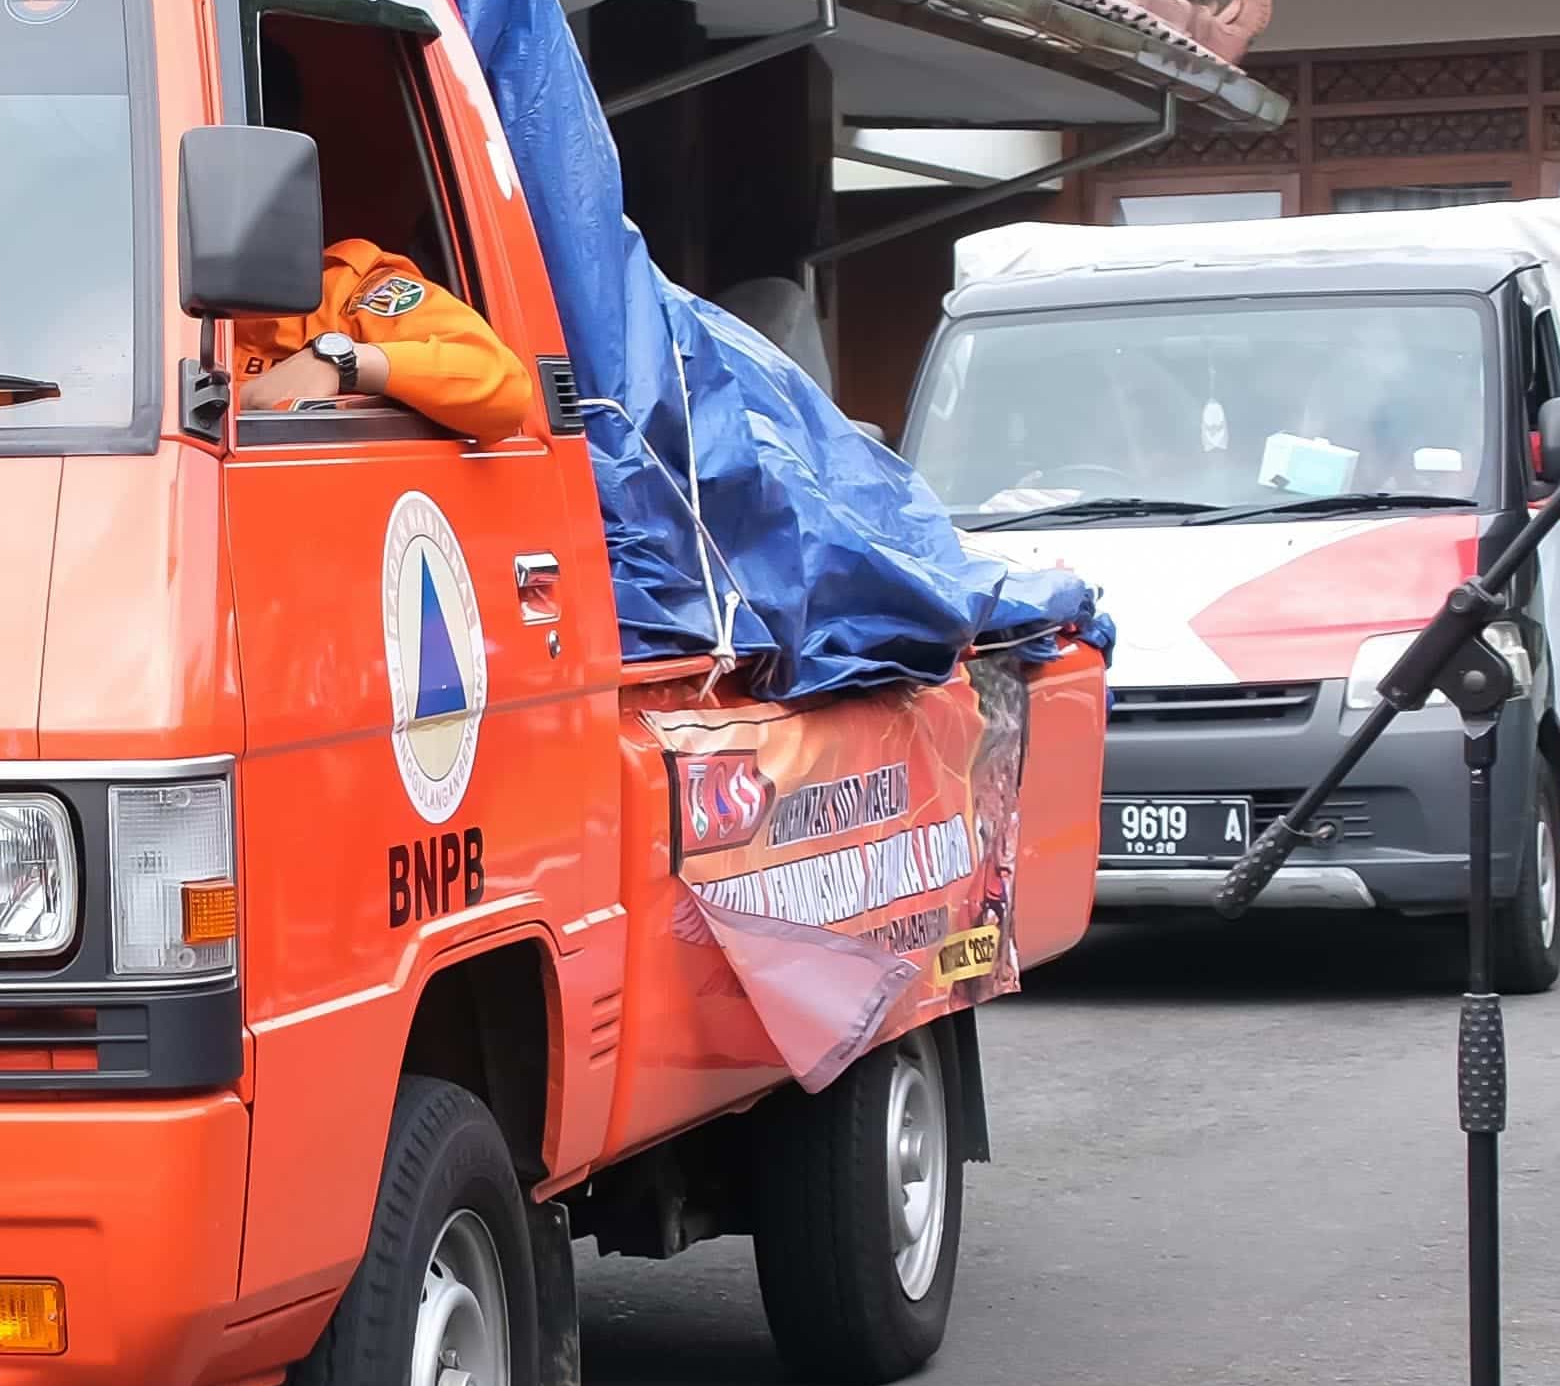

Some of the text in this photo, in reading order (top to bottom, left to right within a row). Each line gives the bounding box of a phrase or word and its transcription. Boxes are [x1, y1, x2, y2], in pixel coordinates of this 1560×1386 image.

[1121, 805, 1243, 842] 9619 A
[388, 827, 485, 929] BNPB
